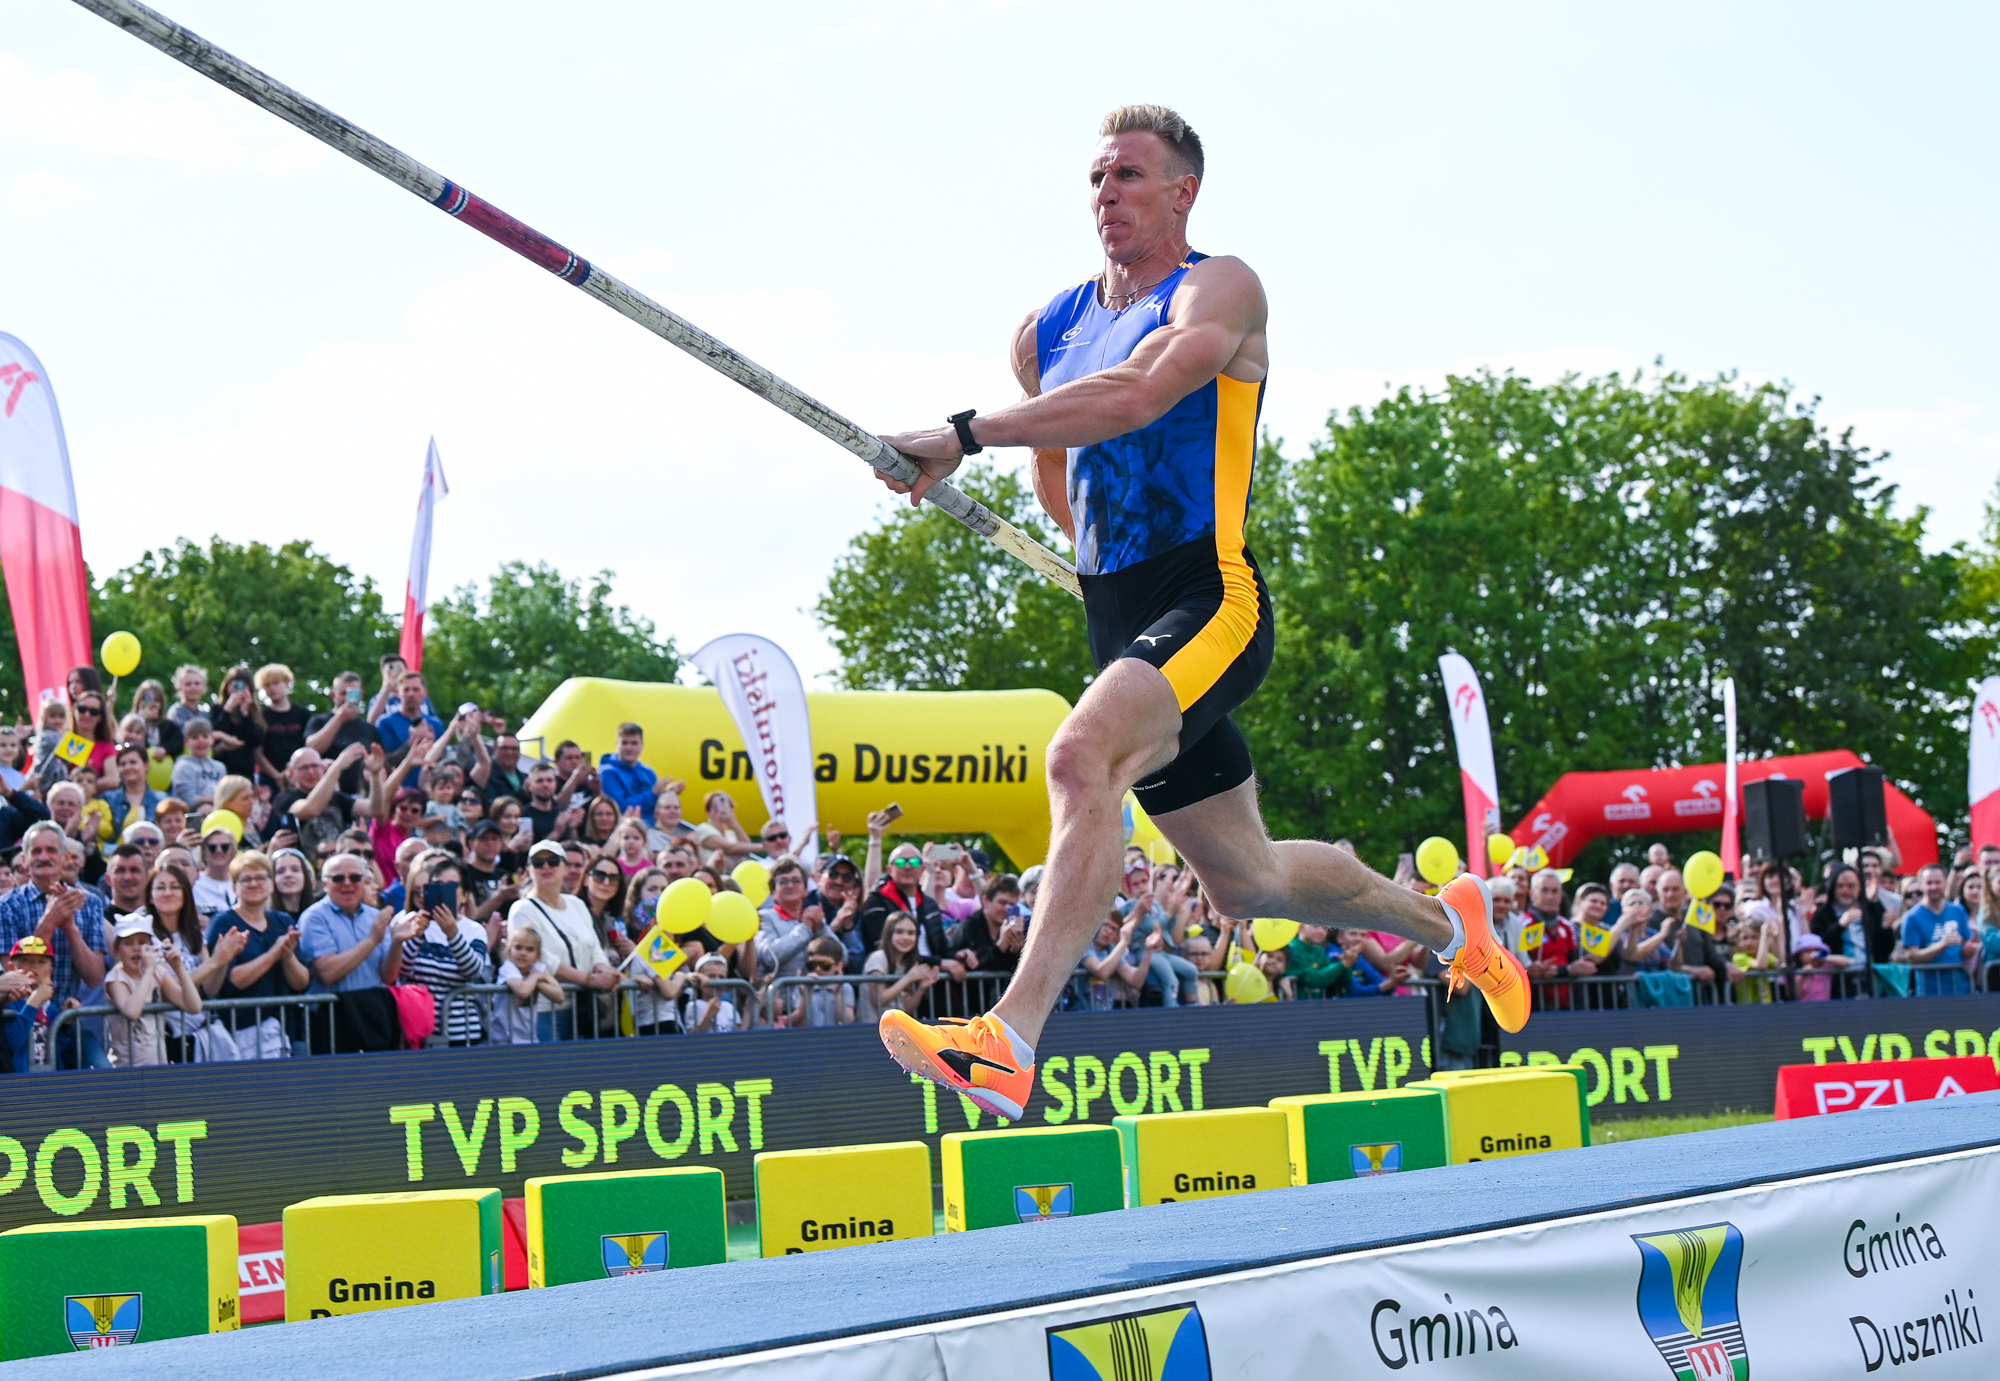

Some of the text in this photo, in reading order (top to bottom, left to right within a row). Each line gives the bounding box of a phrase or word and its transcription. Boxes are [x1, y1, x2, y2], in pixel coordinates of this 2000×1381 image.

[700, 739, 1027, 784] Gma Duszniki
[1041, 1048, 1211, 1124] SPORT
[1318, 1037, 1412, 1093] TVP
[389, 1078, 773, 1182] TVP SPORT
[1481, 1133, 1552, 1154] Gmina
[1174, 1171, 1256, 1193] Gmina
[801, 1216, 894, 1242] Gmina
[1843, 1213, 1946, 1279] Gmina
[329, 1276, 435, 1303] Gmina
[1370, 1293, 1519, 1370] Gmina
[1849, 1288, 1983, 1373] Duszniki
